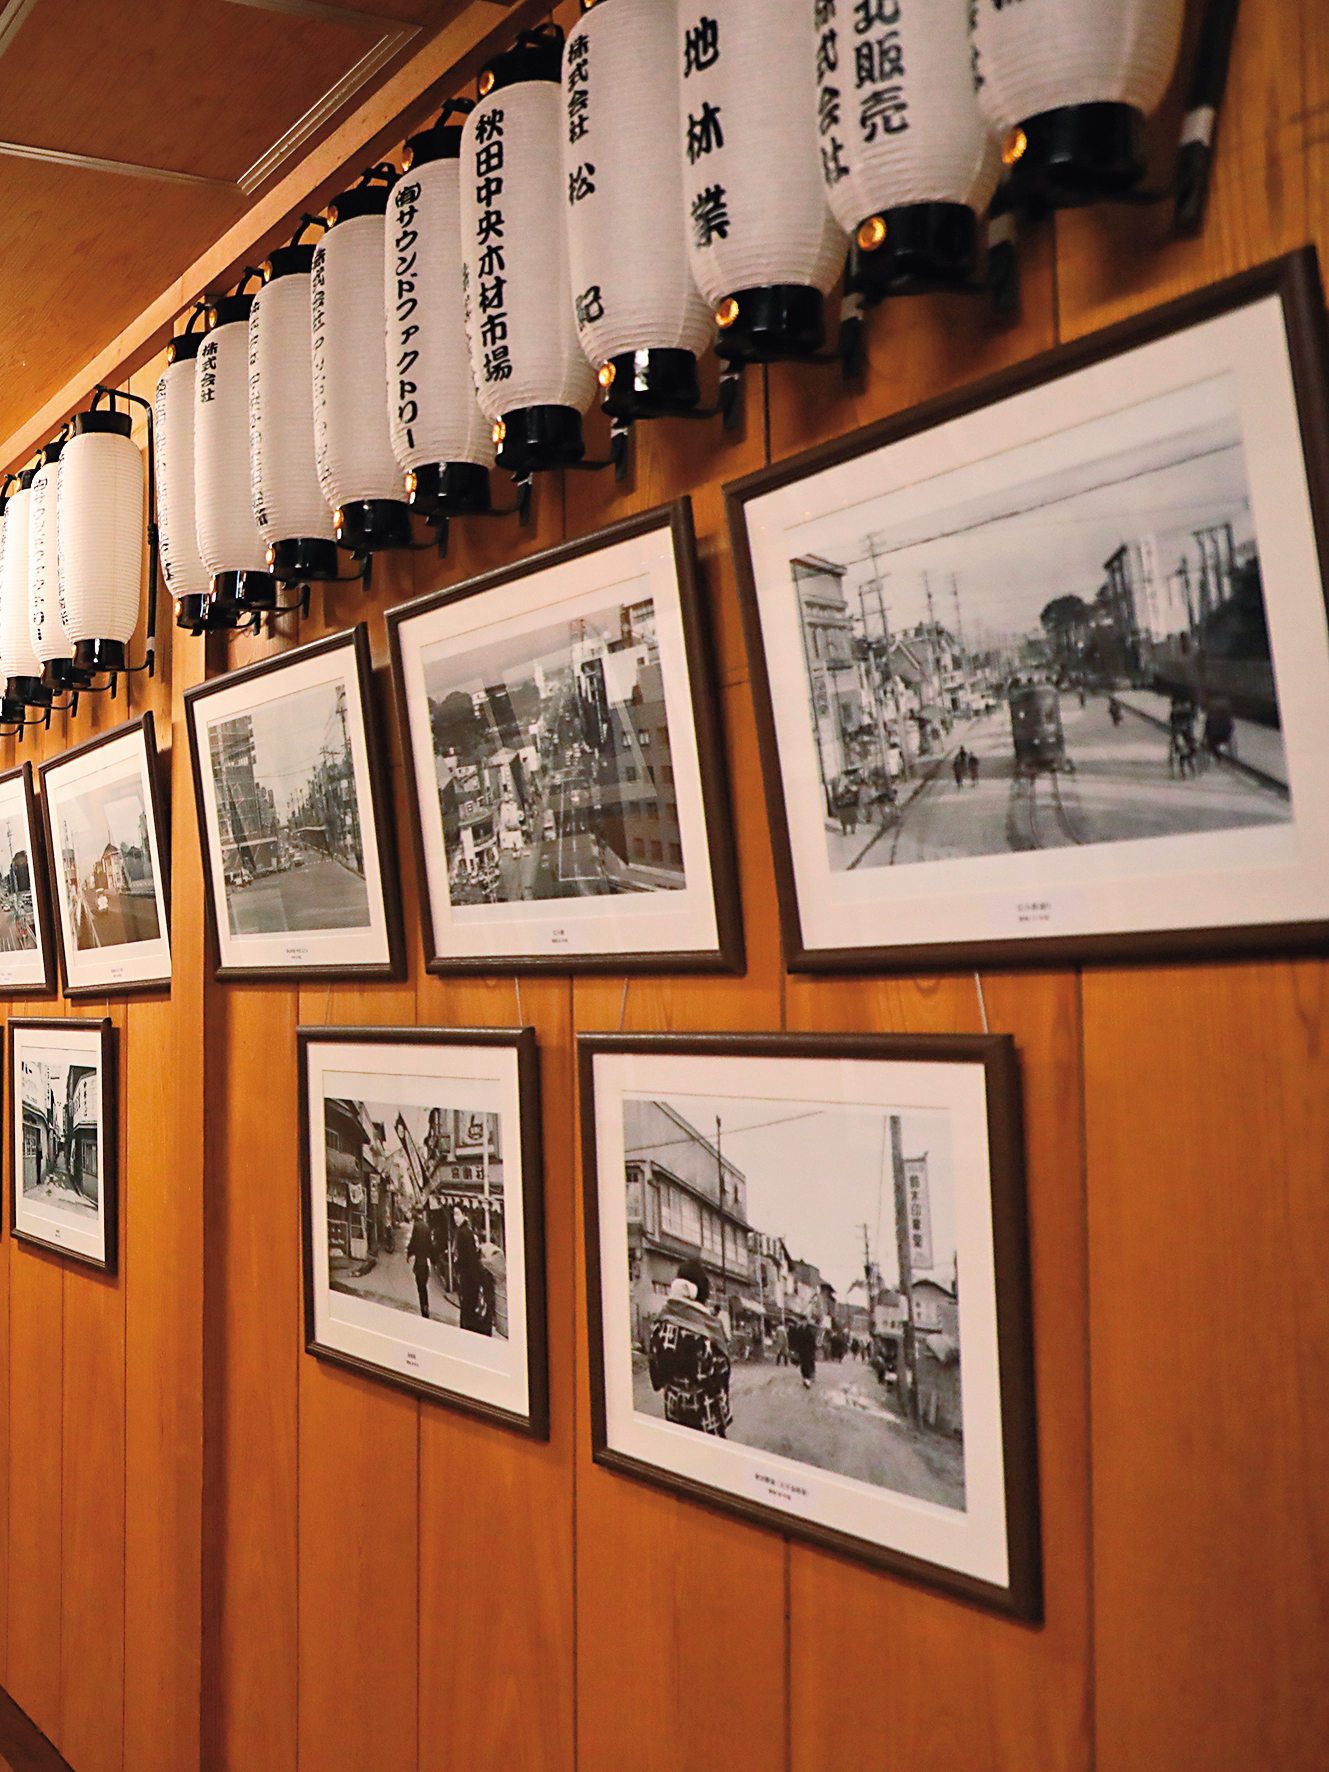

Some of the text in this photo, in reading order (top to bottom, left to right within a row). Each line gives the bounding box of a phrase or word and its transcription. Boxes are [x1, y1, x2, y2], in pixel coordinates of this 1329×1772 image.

[567, 34, 590, 144] 株式会社
[474, 108, 514, 383] 秋田中央木材市場
[200, 342, 218, 402] 株式会社
